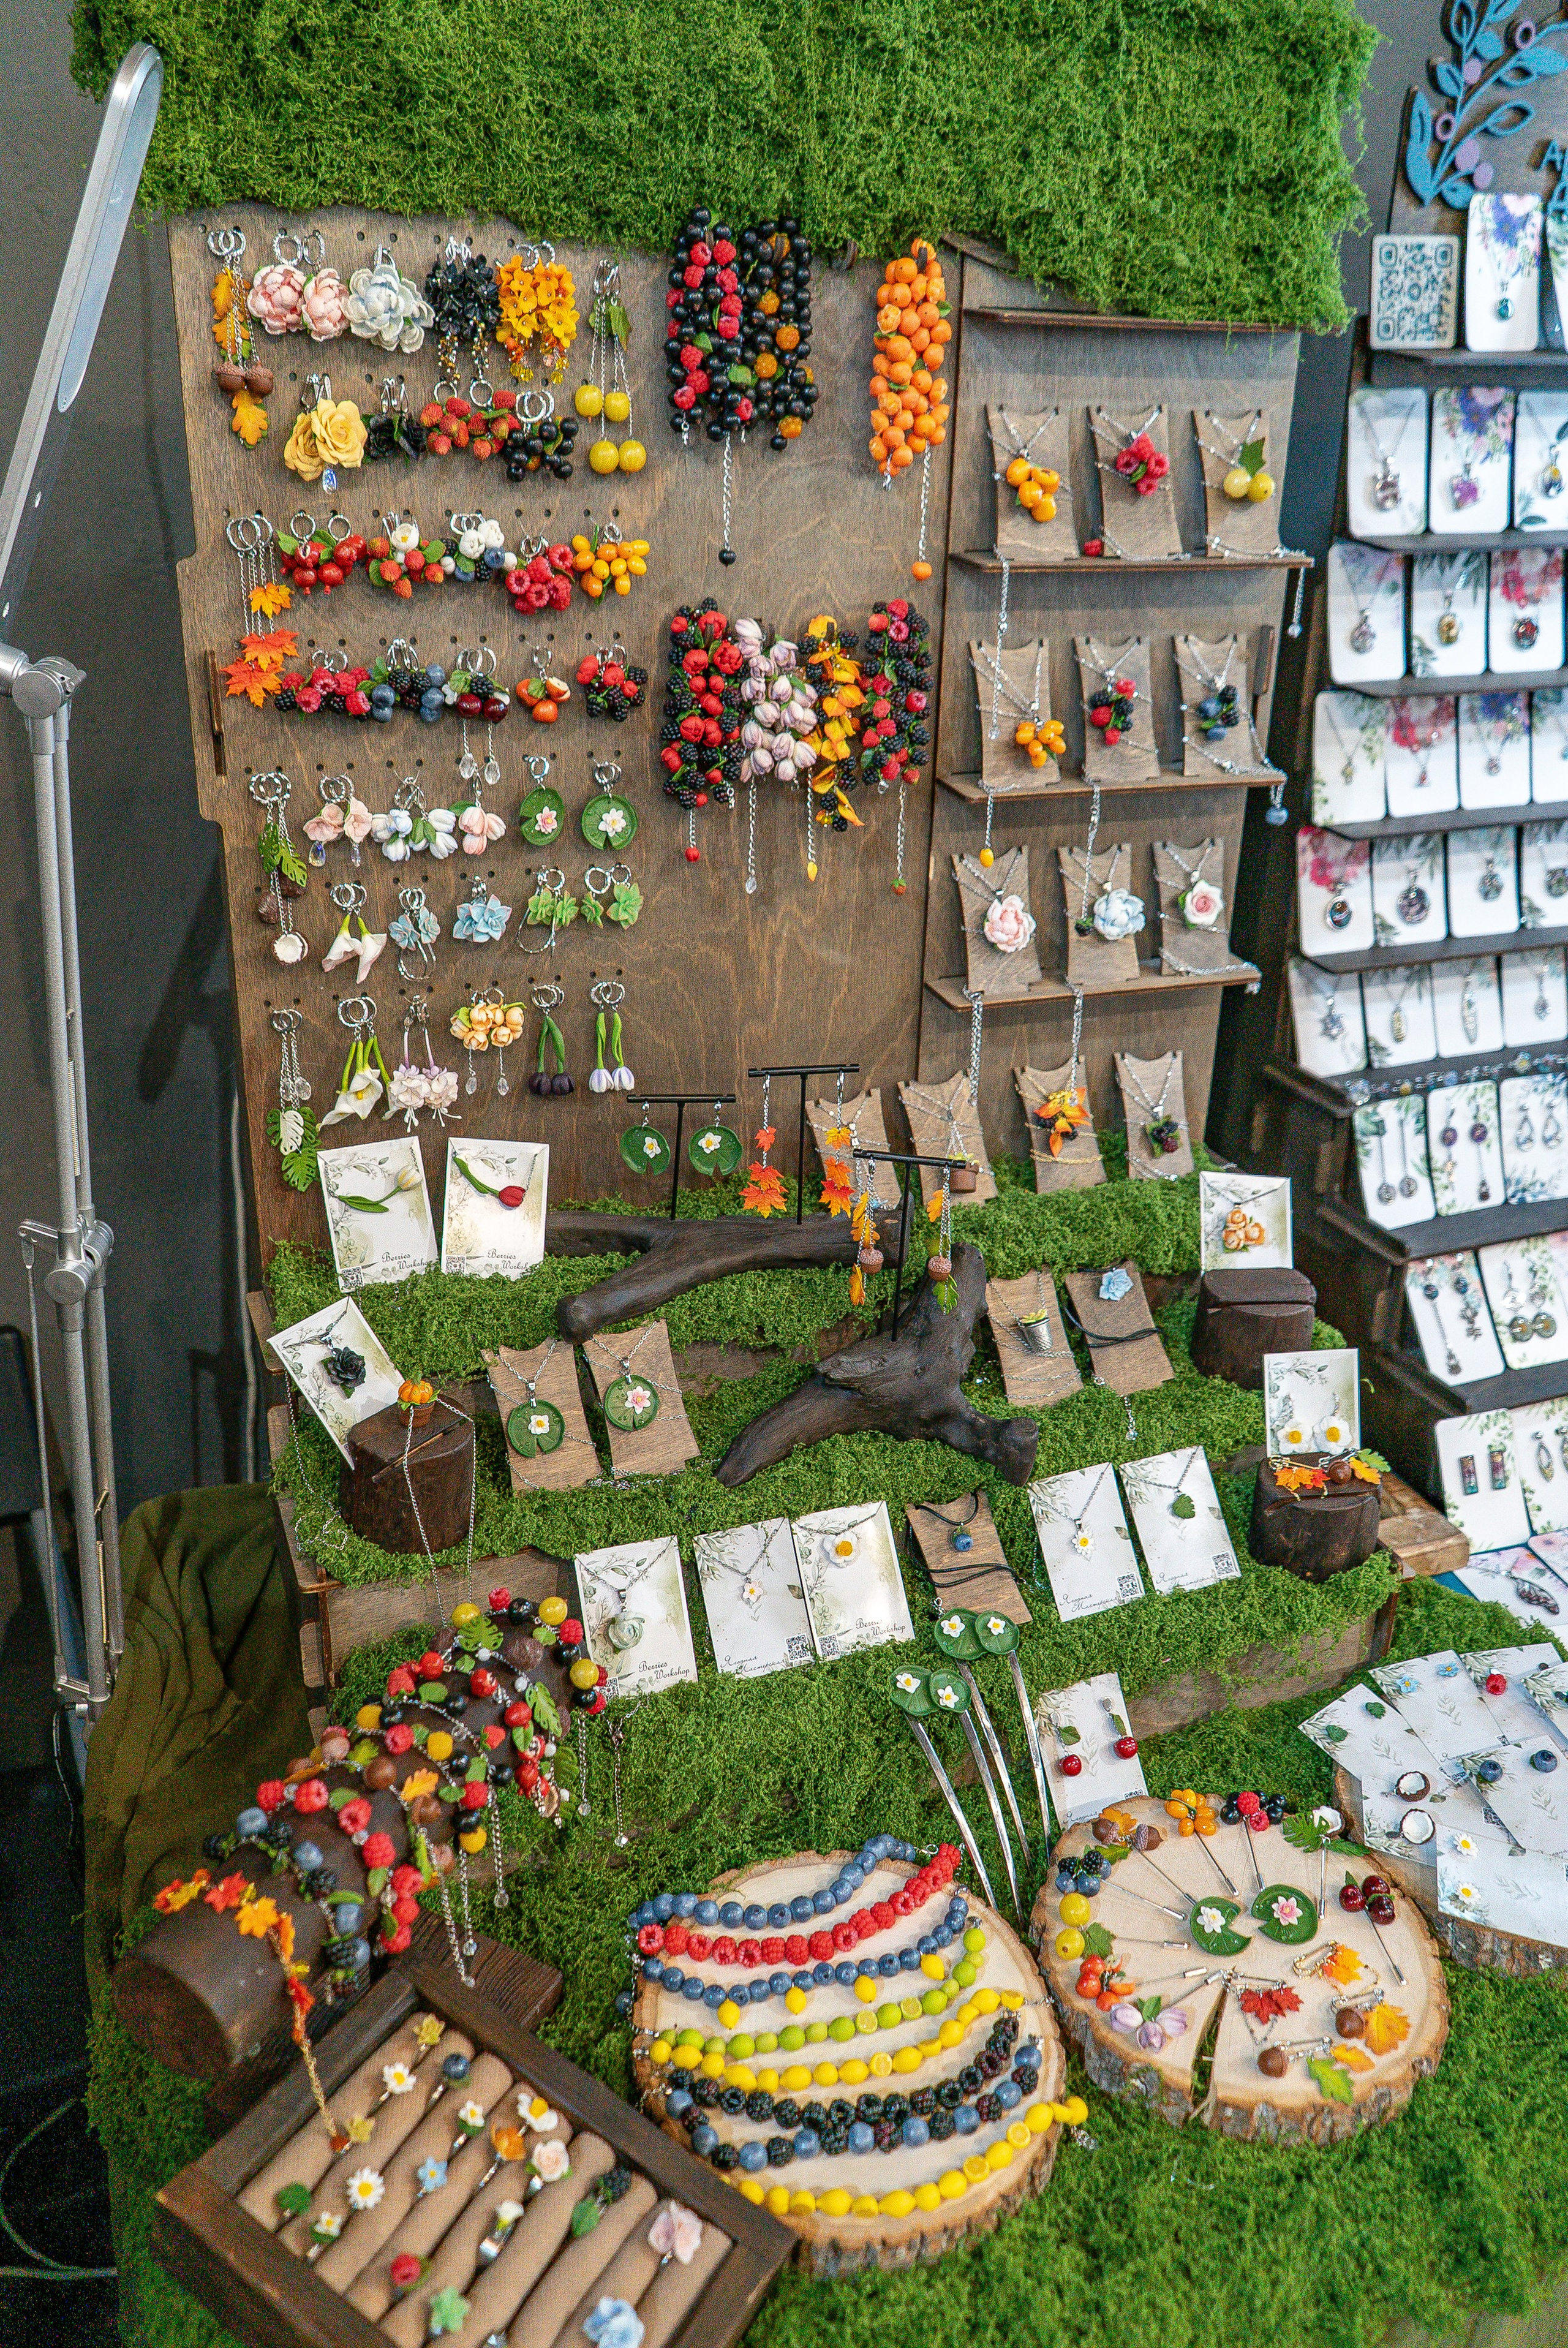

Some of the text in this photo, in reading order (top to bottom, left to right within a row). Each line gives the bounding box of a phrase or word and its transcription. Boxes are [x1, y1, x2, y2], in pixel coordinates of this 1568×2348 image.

[382, 1251, 411, 1263] Berries
[488, 1248, 516, 1259] Berries
[397, 1258, 431, 1270] Worksho
[638, 1660, 668, 1673] Berries
[654, 1666, 690, 1680] Workshop
